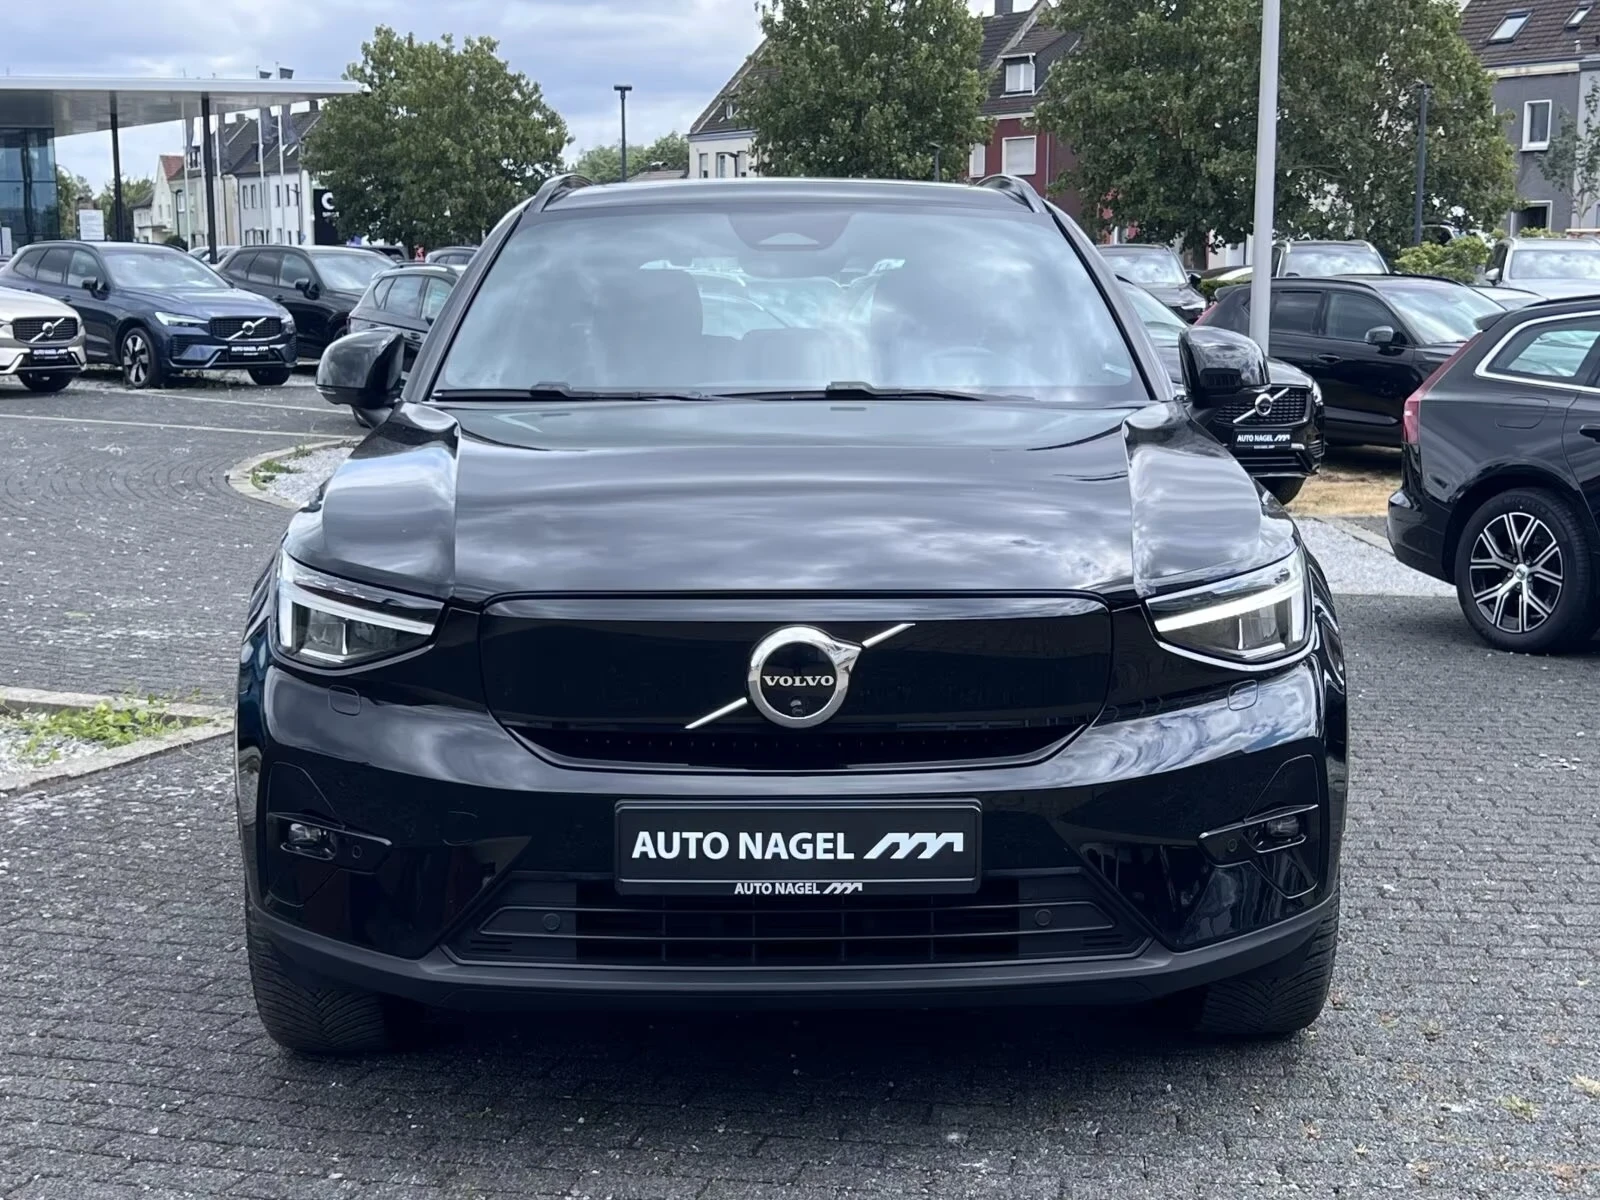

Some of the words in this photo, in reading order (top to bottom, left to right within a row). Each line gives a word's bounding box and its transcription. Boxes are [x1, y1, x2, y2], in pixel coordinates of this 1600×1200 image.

[1237, 434, 1254, 442] AUTO
[1254, 434, 1274, 442] NAGEL
[762, 675, 836, 688] VOLVO
[631, 831, 730, 861] AUTO
[738, 831, 855, 861] NAGEL
[734, 882, 773, 896] AUTO
[775, 882, 821, 896] NAGEL
